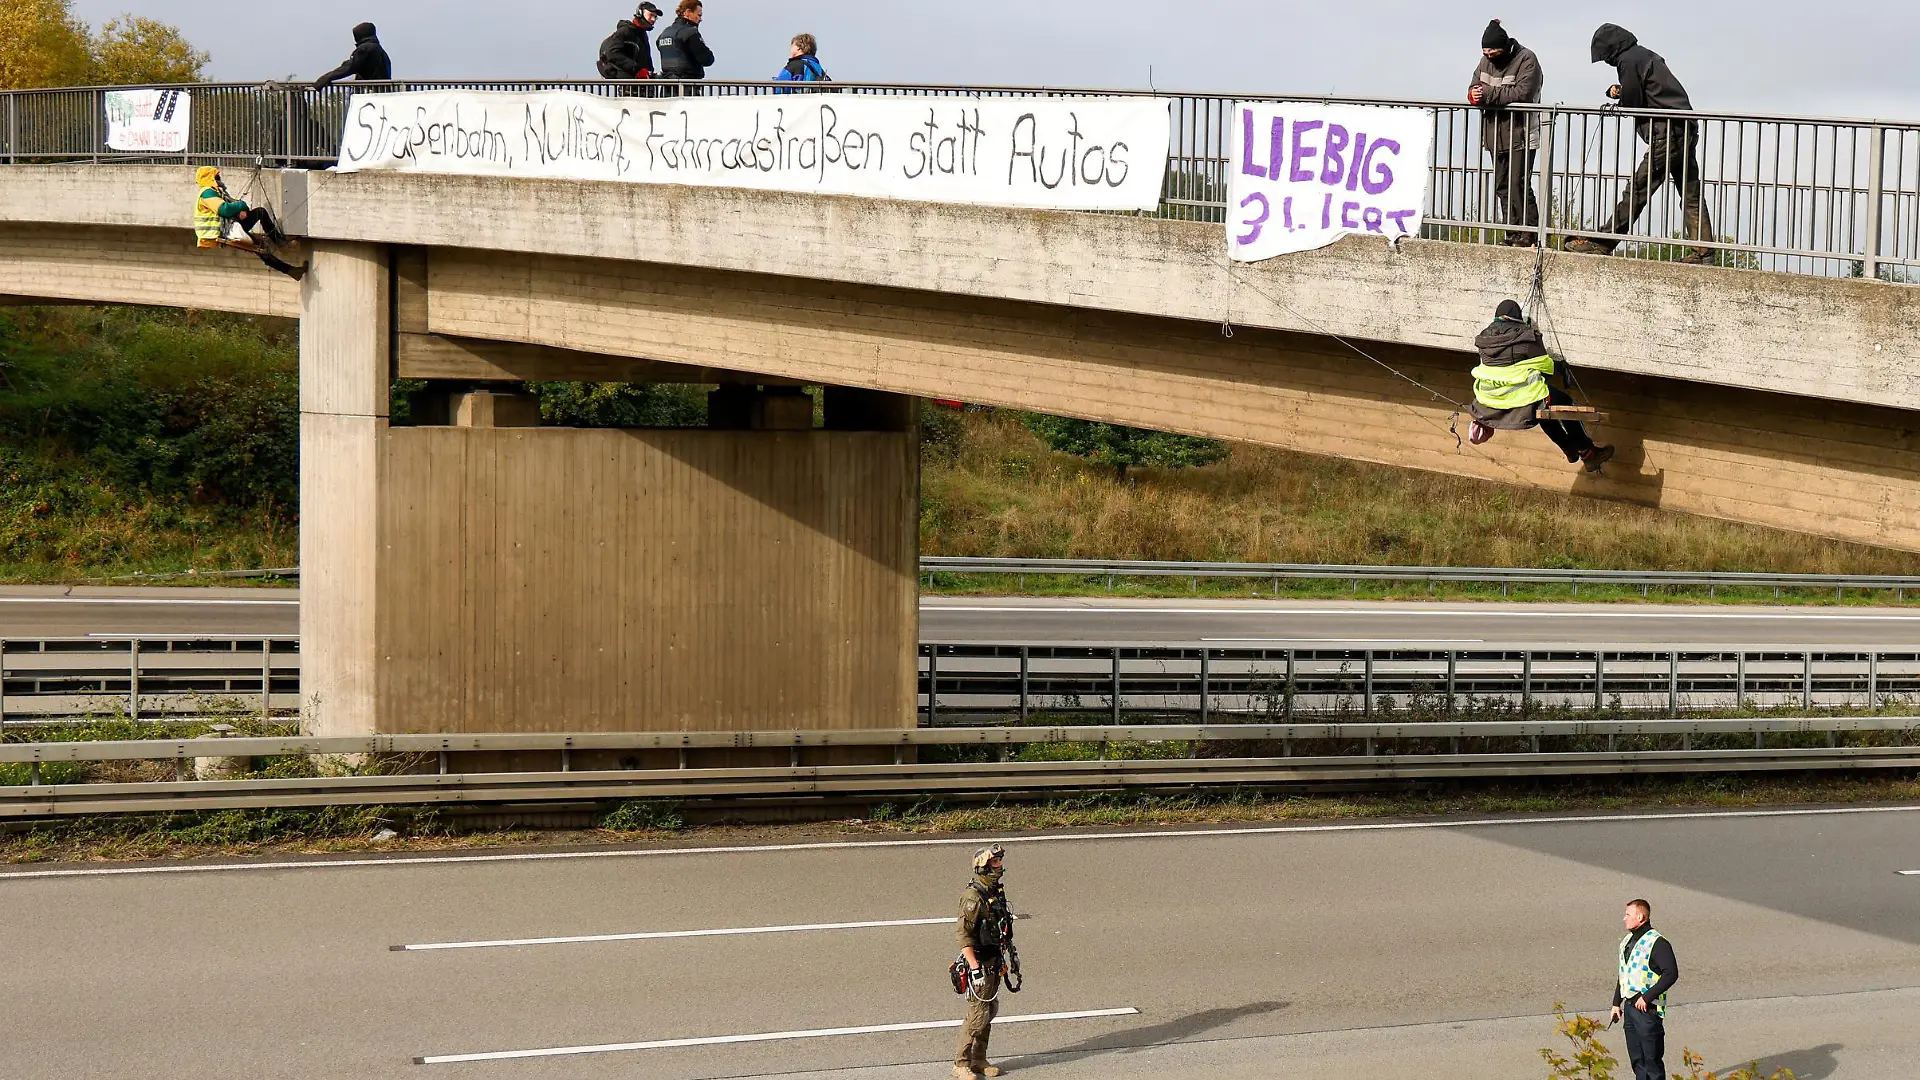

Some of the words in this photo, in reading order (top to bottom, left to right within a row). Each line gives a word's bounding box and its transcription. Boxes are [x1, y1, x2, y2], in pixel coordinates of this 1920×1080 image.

[646, 105, 883, 184] Fahrradstraßen
[904, 108, 985, 178] statt
[1009, 113, 1128, 189] Autos
[1242, 108, 1401, 195] LIEBIG
